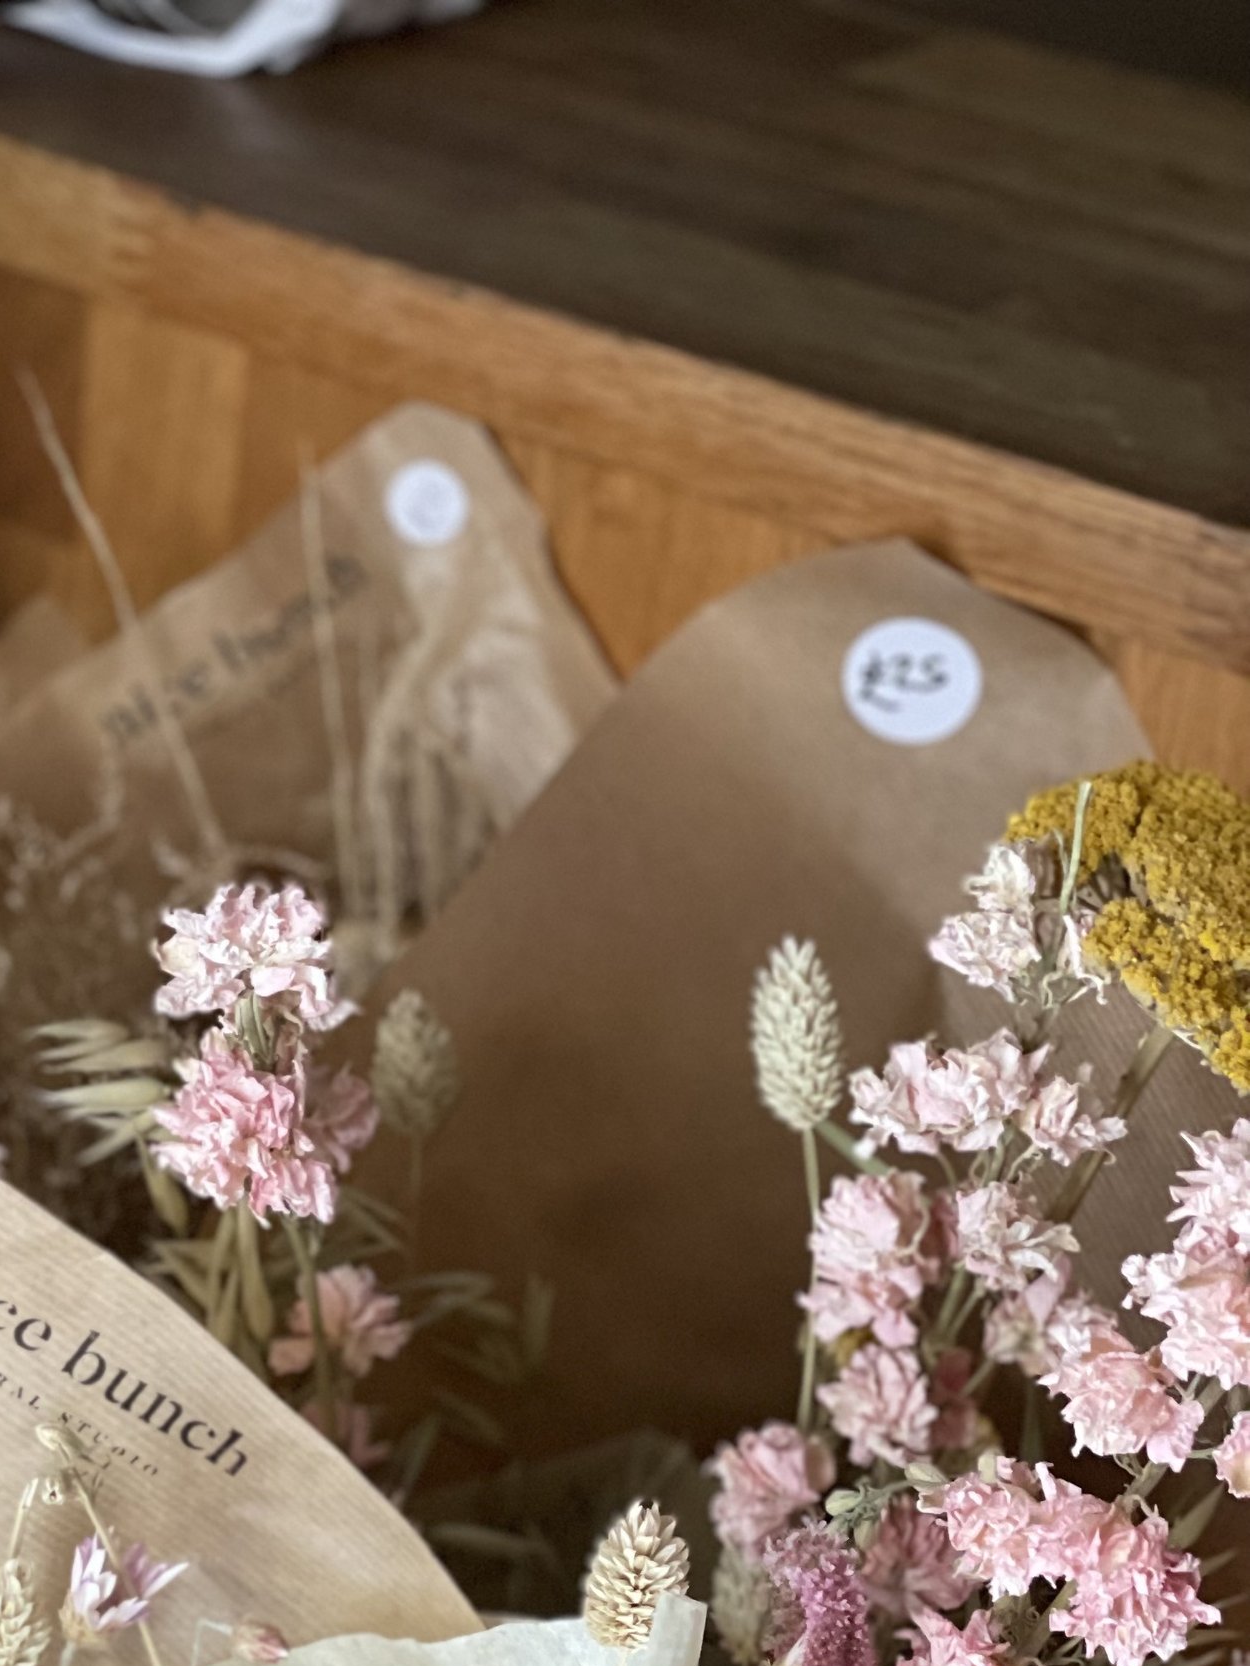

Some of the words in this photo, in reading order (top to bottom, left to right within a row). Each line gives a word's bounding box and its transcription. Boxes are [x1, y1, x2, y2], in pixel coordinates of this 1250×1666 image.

[860, 649, 949, 713] £25
[61, 1329, 248, 1477] bunch
[58, 1411, 158, 1477] STUDIO
